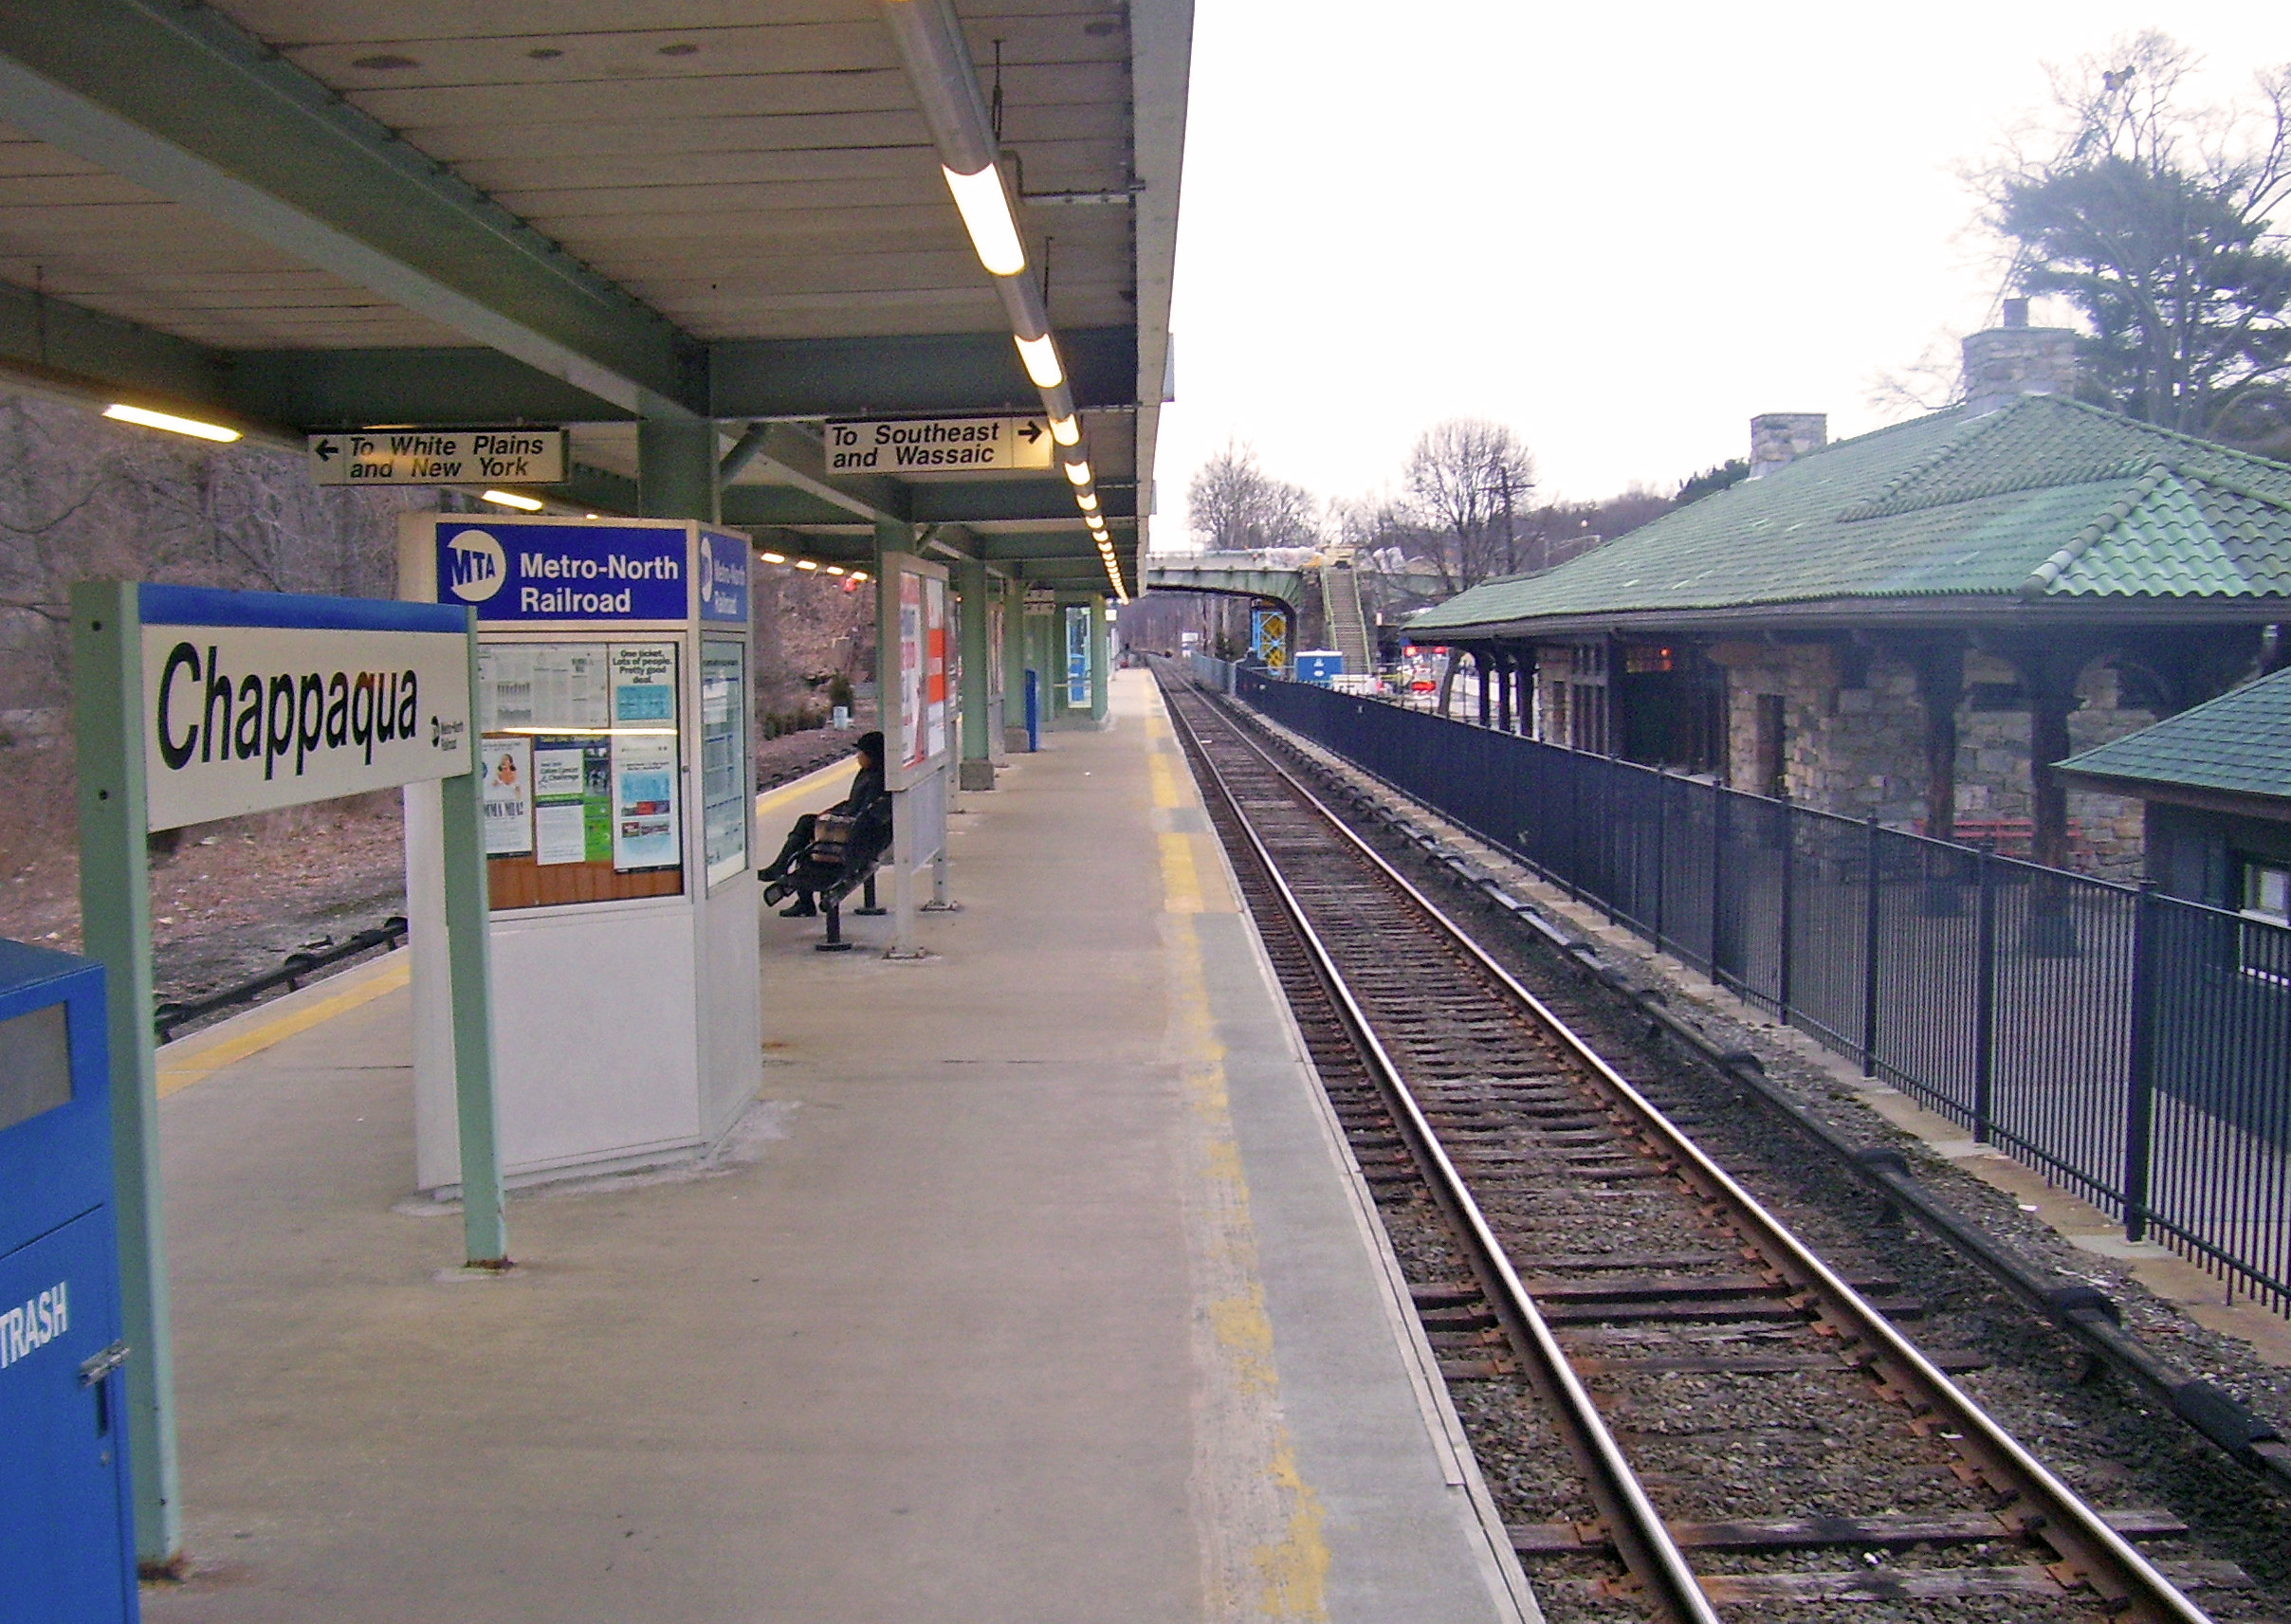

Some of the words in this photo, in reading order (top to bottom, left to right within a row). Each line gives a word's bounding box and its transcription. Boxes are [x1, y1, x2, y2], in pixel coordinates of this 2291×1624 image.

[350, 437, 374, 456] To
[391, 437, 456, 456] White
[473, 436, 543, 455] Plains
[833, 427, 857, 446] To
[874, 423, 999, 445] Southeast
[350, 459, 392, 478] and
[412, 458, 462, 477] New
[480, 457, 528, 477] York
[833, 448, 878, 467] and
[896, 445, 995, 465] Wassaic
[451, 547, 496, 587] MTA
[521, 553, 679, 580] Metro-North
[522, 587, 631, 612] Railroad
[157, 642, 417, 781] Chappaqua
[0, 1282, 68, 1369] TRASH
